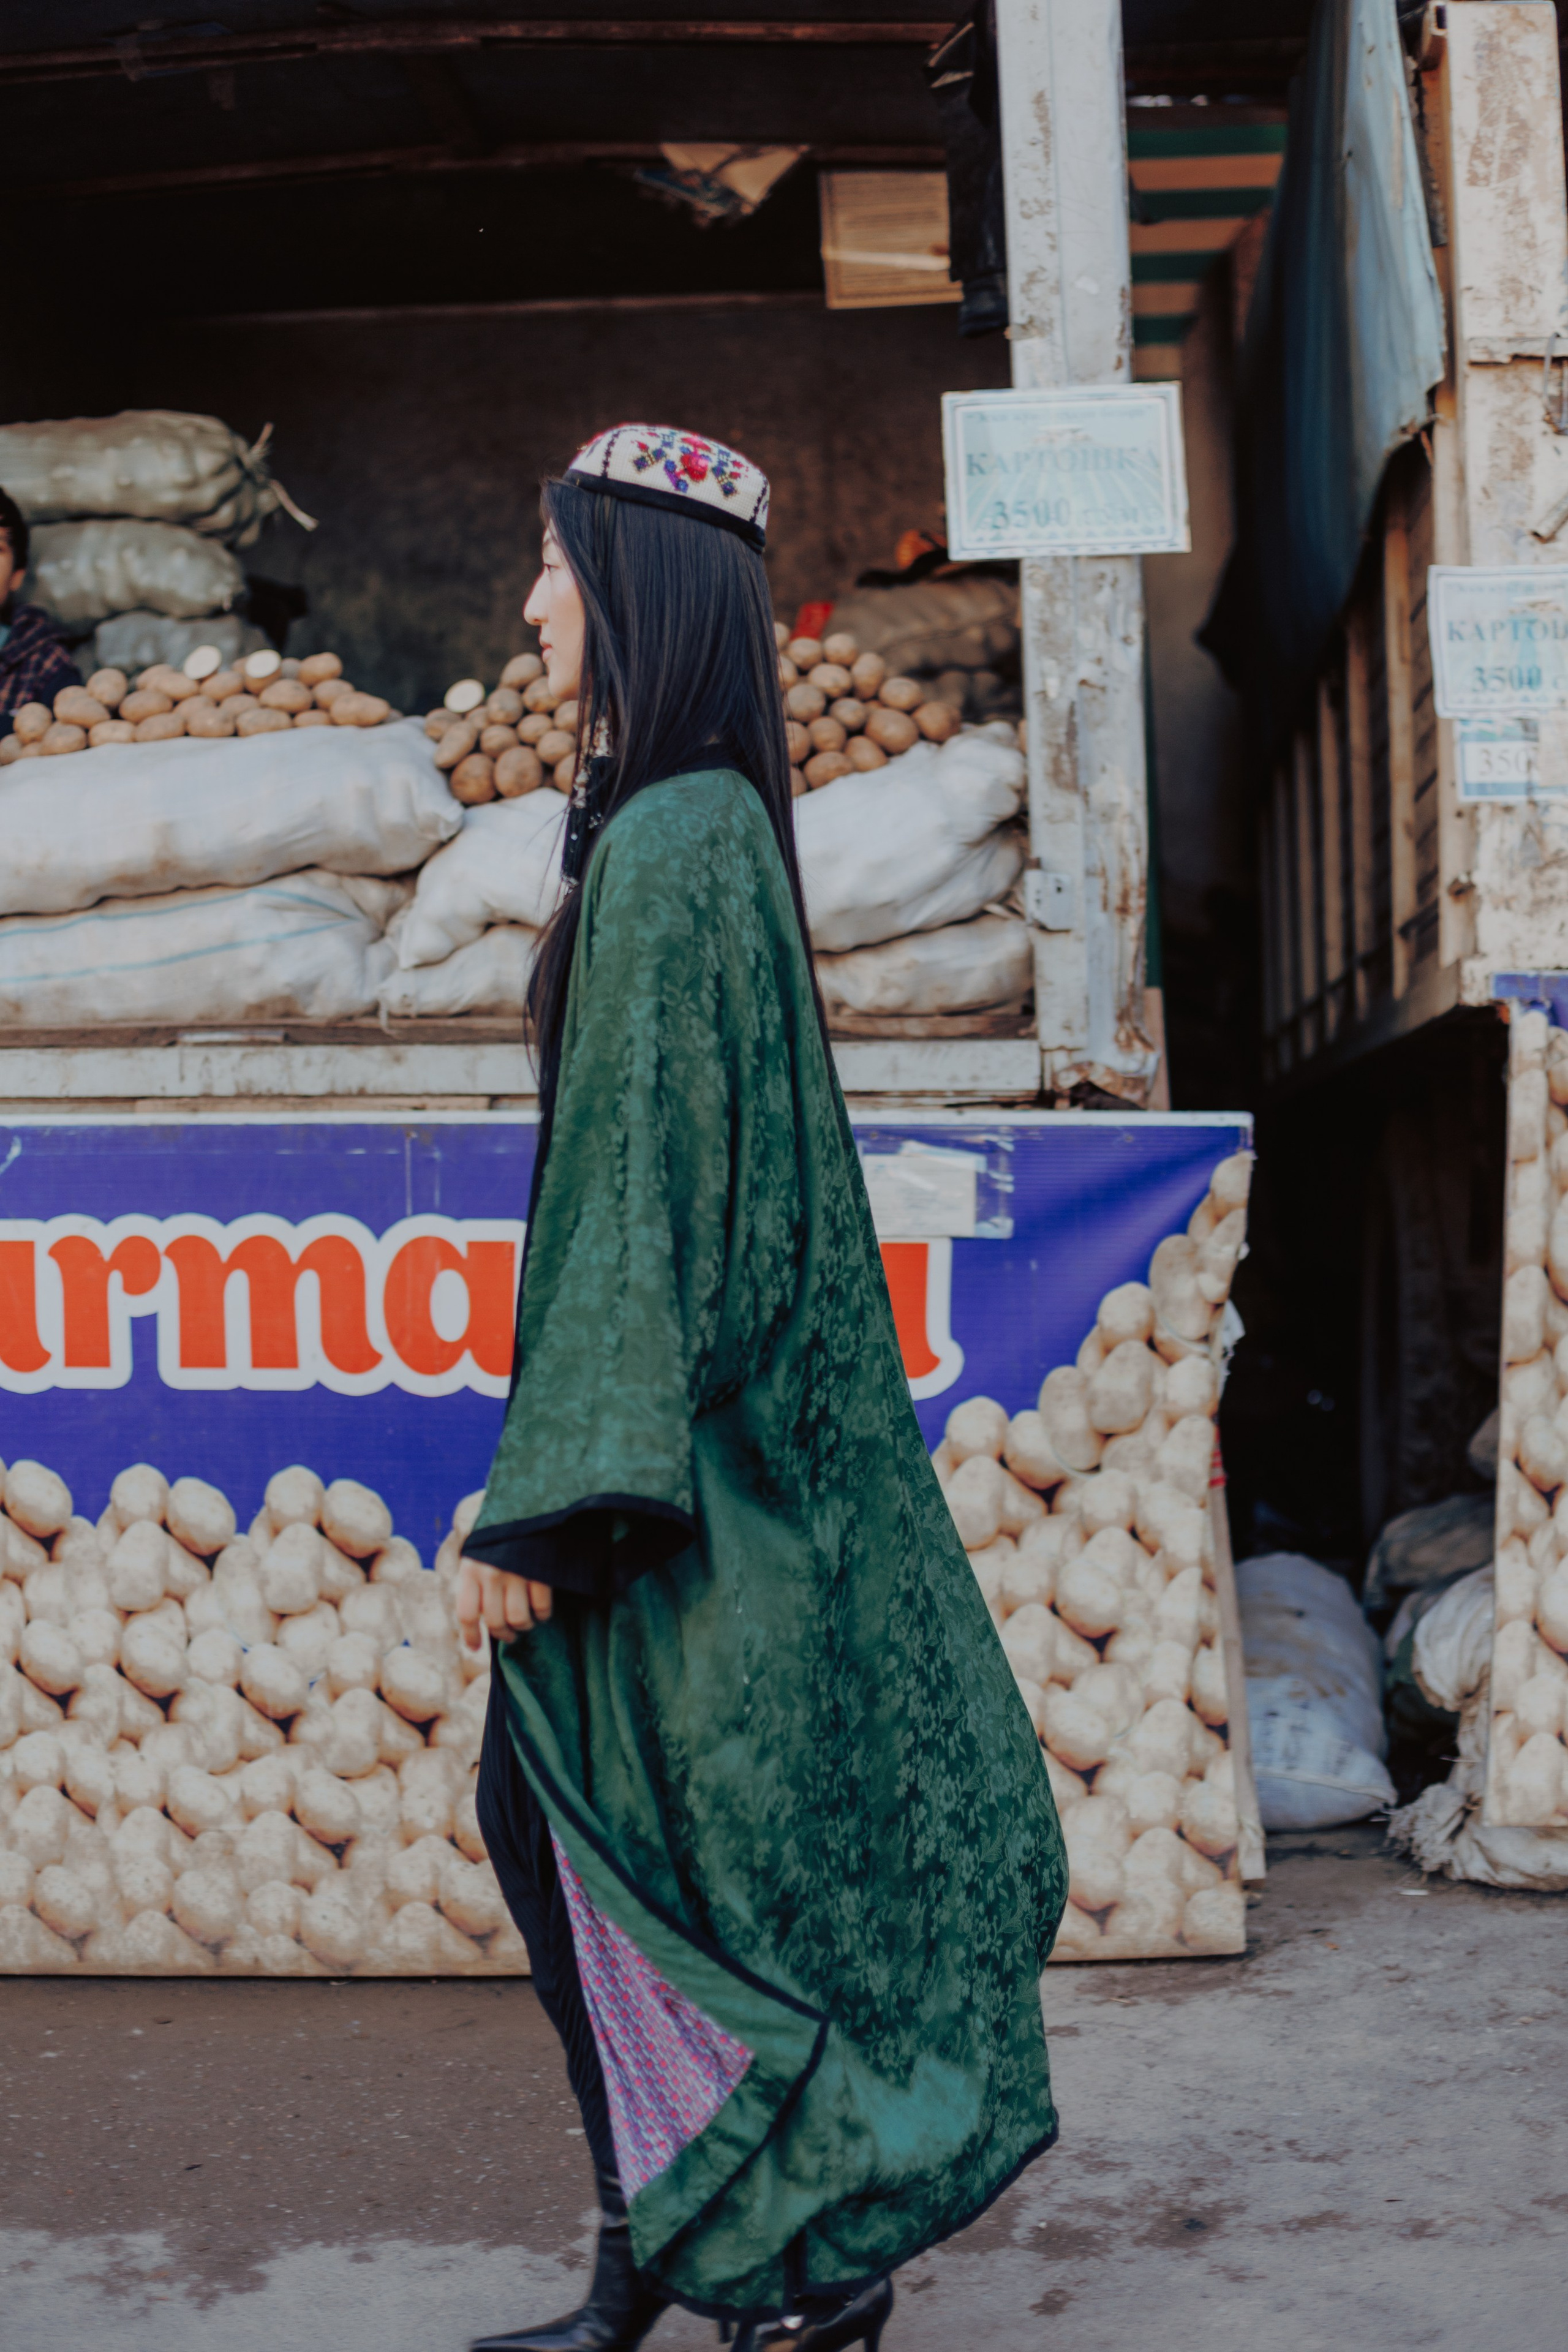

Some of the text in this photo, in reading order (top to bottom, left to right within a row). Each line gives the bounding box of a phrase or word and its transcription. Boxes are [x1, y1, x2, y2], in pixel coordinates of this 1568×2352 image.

[966, 447, 1160, 477] КАРТОШКА
[991, 497, 1071, 530] 3500
[1472, 665, 1543, 693] 3500
